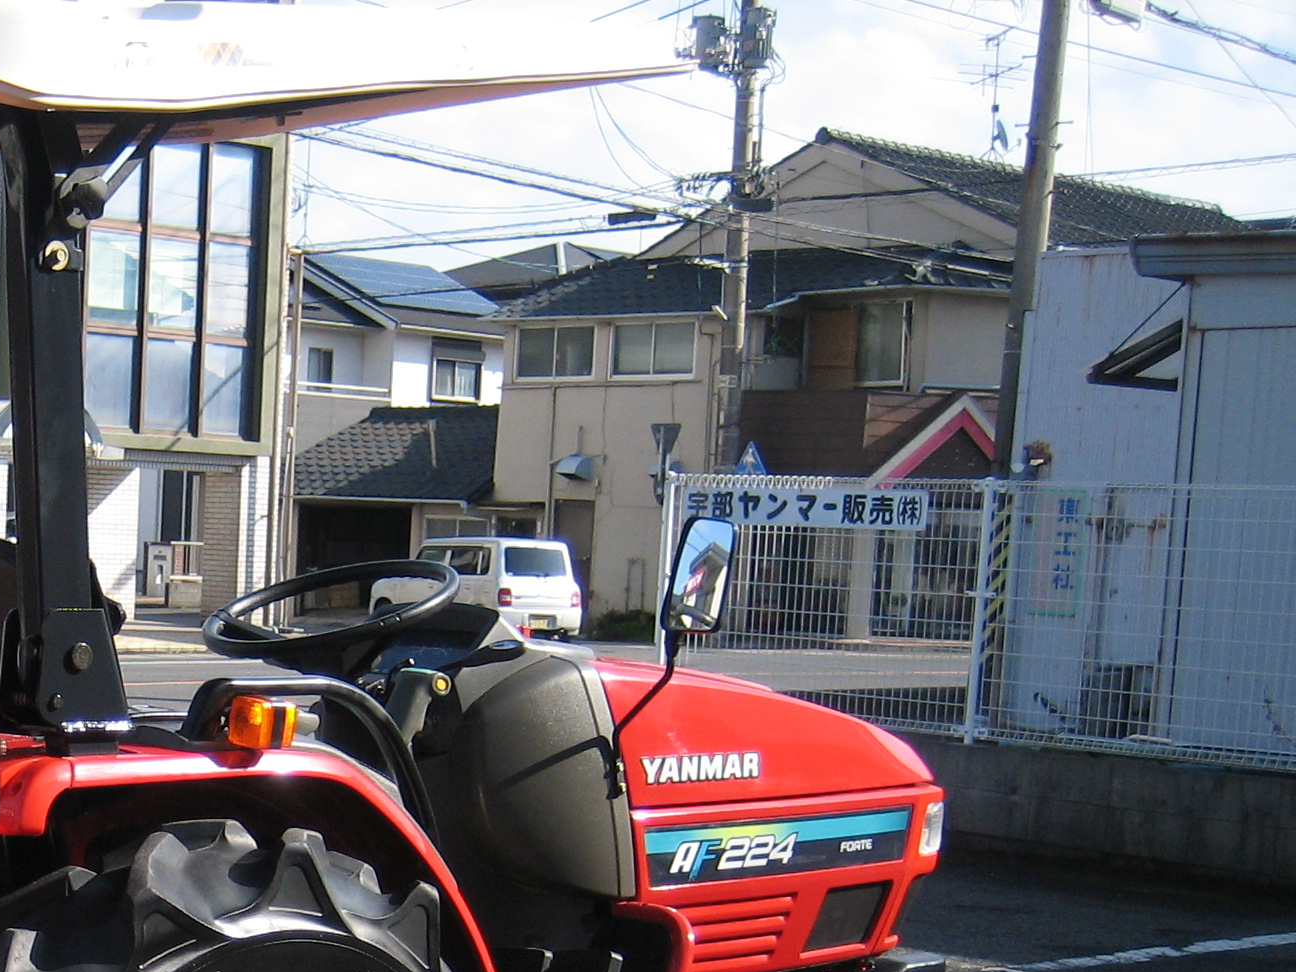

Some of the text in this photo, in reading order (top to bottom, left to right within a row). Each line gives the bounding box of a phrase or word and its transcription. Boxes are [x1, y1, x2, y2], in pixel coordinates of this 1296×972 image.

[641, 751, 760, 785] YANMAR
[668, 831, 799, 882] AF224
[839, 838, 873, 853] FORTE
